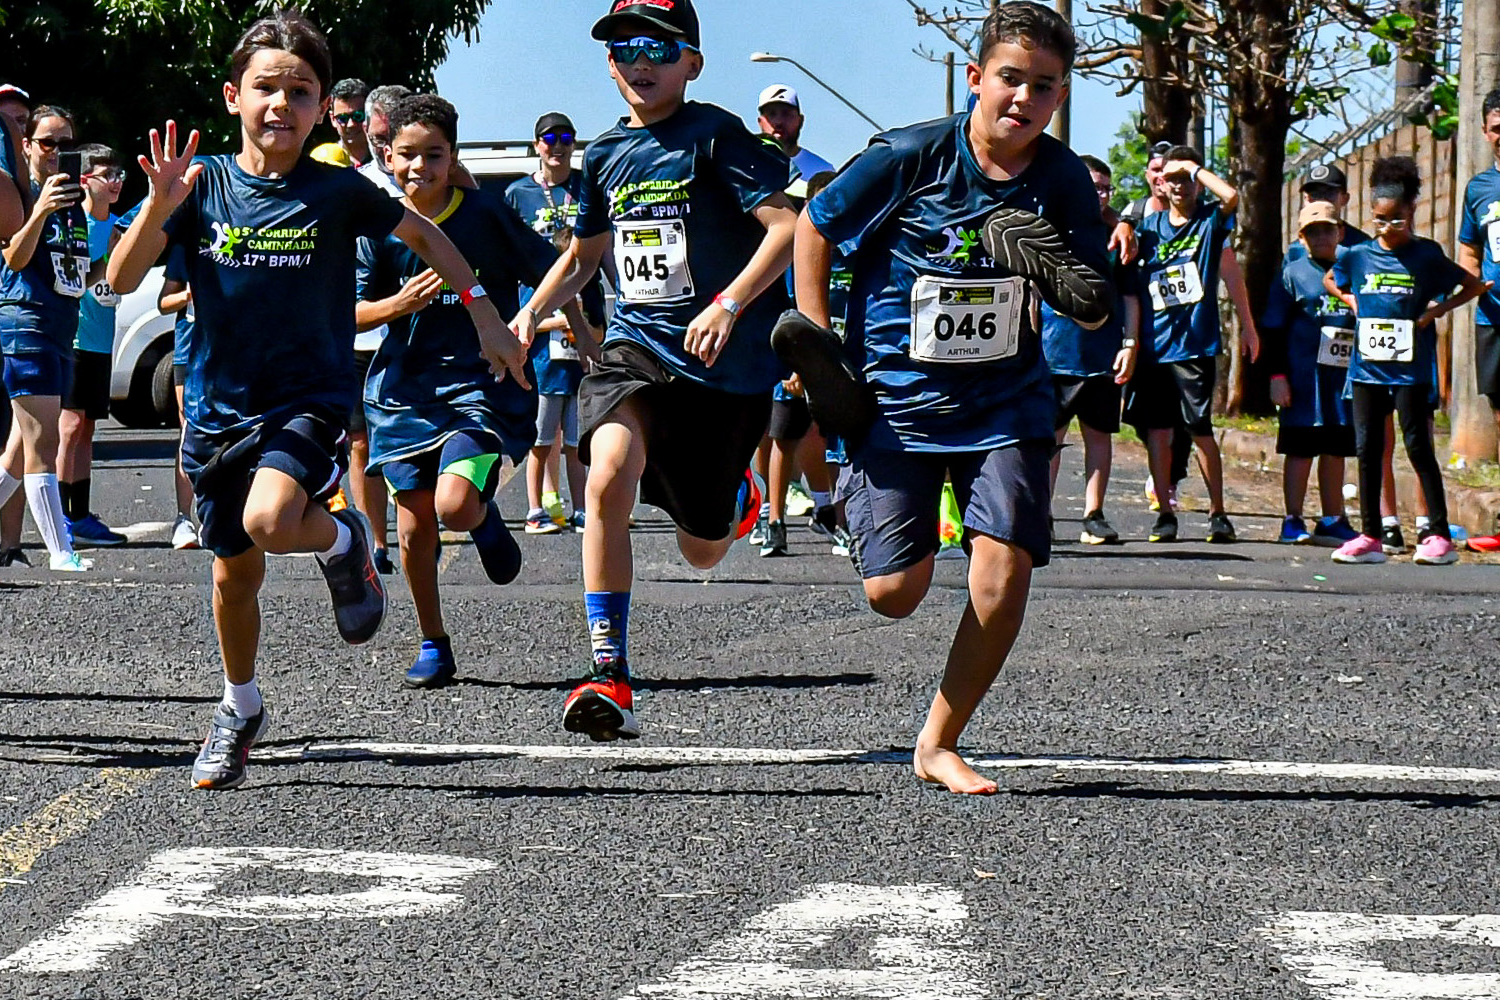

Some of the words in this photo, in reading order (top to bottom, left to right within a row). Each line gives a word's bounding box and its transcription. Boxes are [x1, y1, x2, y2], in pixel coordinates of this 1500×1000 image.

[257, 227, 308, 238] CORRIDA
[310, 228, 318, 237] E
[247, 240, 315, 251] CAMINHADA
[624, 253, 670, 282] 045
[980, 256, 995, 268] 17
[635, 288, 660, 296] THUR
[1160, 281, 1187, 298] 008
[442, 294, 461, 305] BP
[934, 312, 997, 341] 046
[1369, 336, 1397, 349] 042
[947, 347, 981, 356] ARTHUR
[1330, 343, 1352, 358] 05
